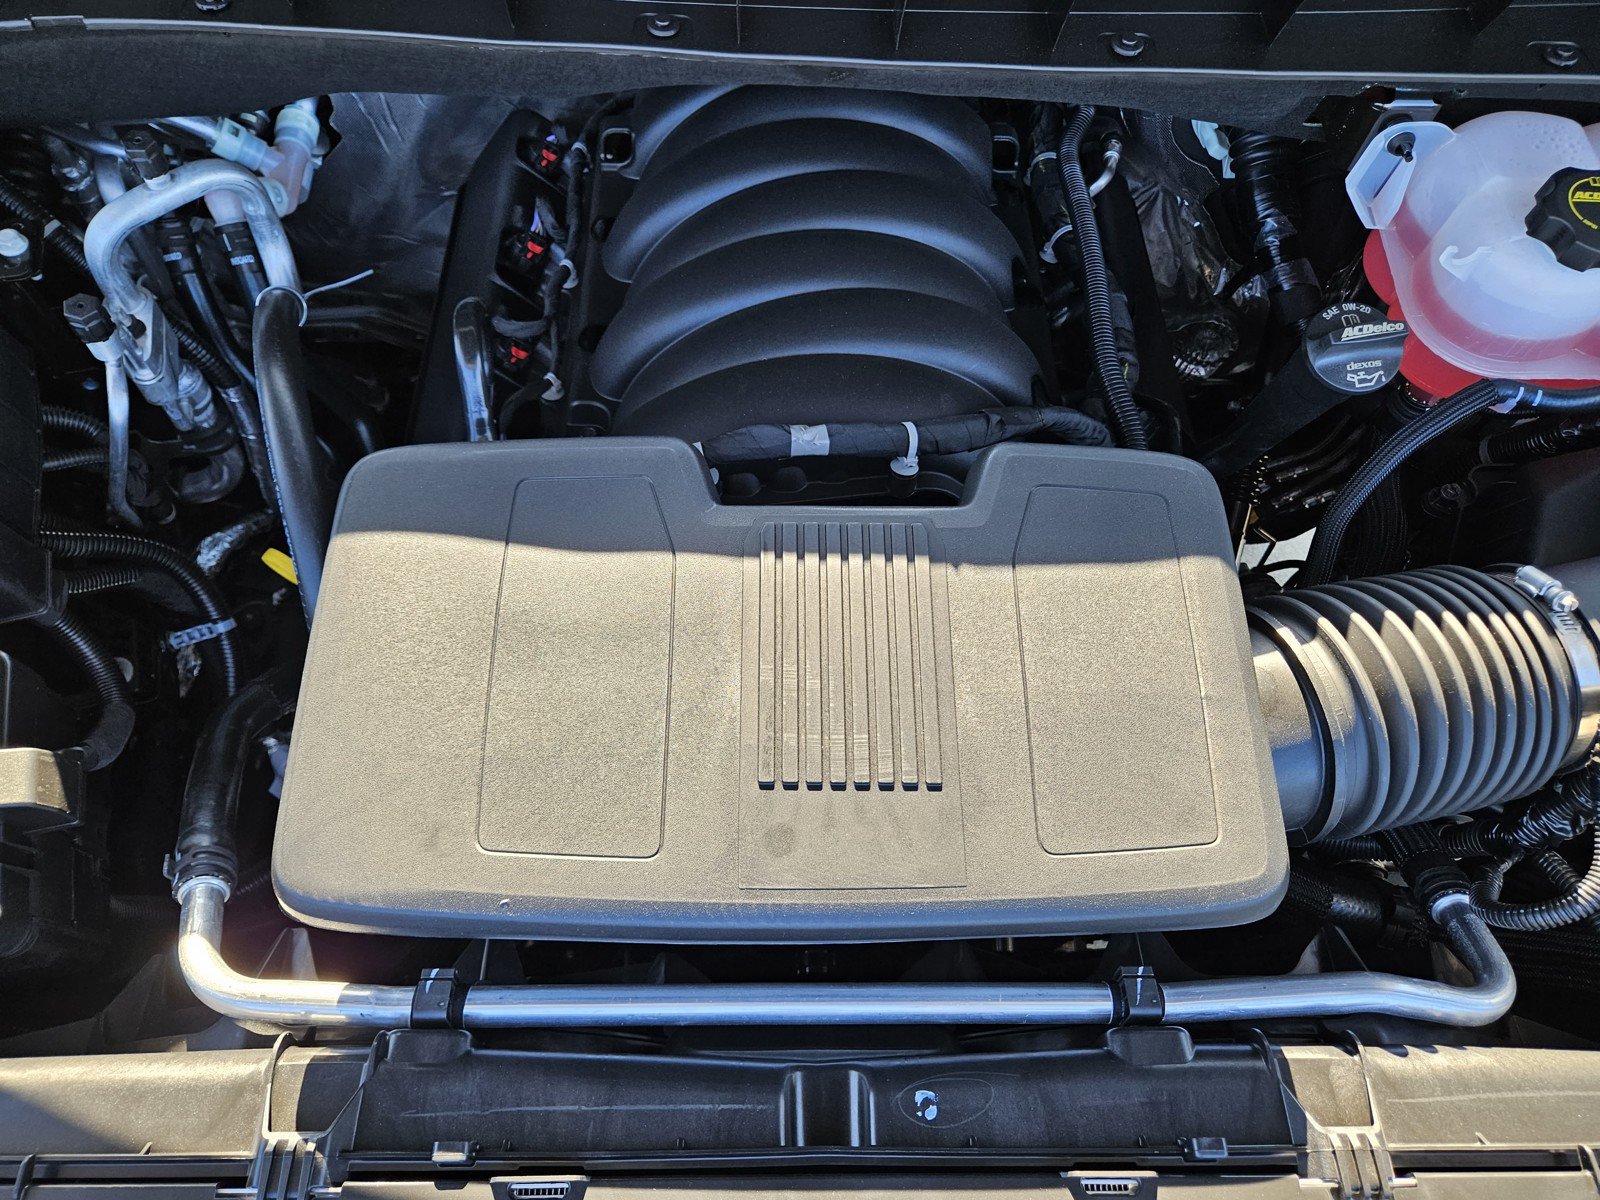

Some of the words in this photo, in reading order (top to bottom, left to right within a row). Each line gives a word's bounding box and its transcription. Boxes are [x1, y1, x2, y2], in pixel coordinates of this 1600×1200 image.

[1322, 306, 1340, 320] SAE
[1342, 303, 1371, 314] 0W-20
[1341, 321, 1404, 339] ACDelco
[1346, 359, 1382, 371] dexos
